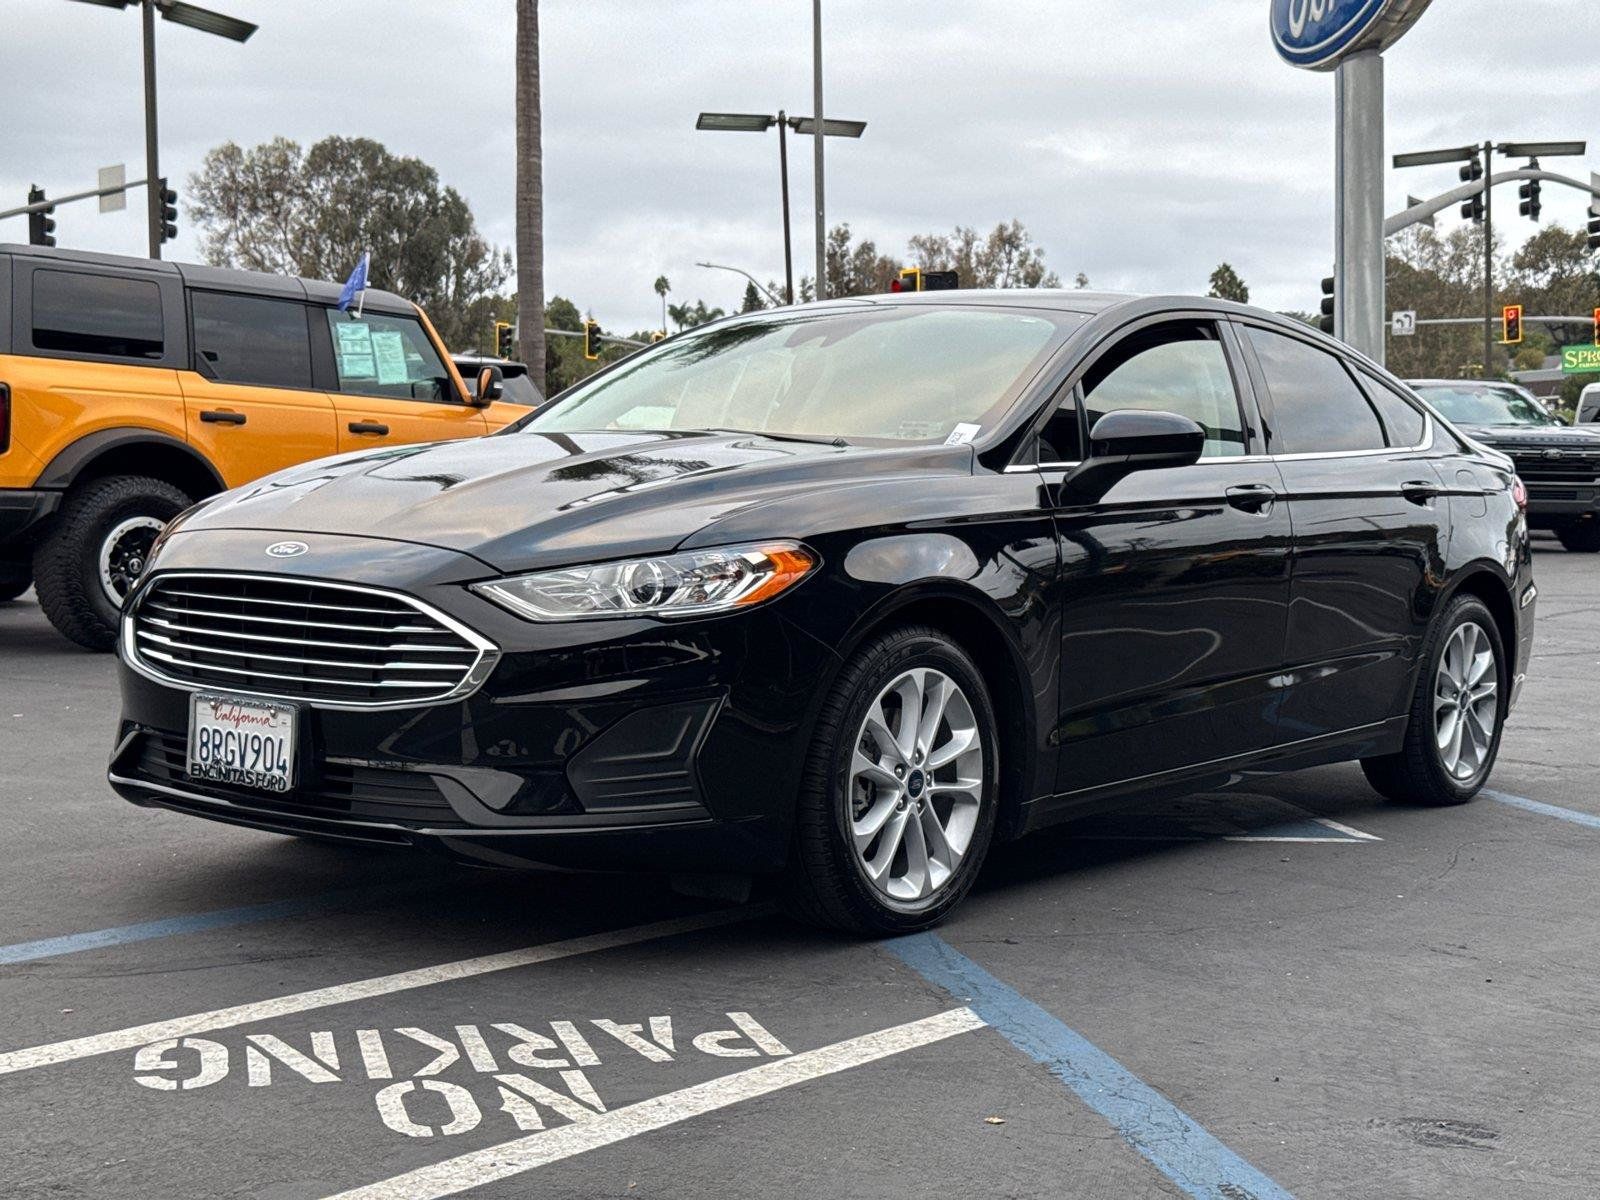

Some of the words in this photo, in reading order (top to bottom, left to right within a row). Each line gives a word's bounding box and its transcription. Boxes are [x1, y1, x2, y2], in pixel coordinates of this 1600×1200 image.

[214, 702, 277, 729] California
[199, 726, 288, 776] 8RGV904
[133, 1011, 793, 1090] PARKING
[376, 1067, 606, 1137] NO
